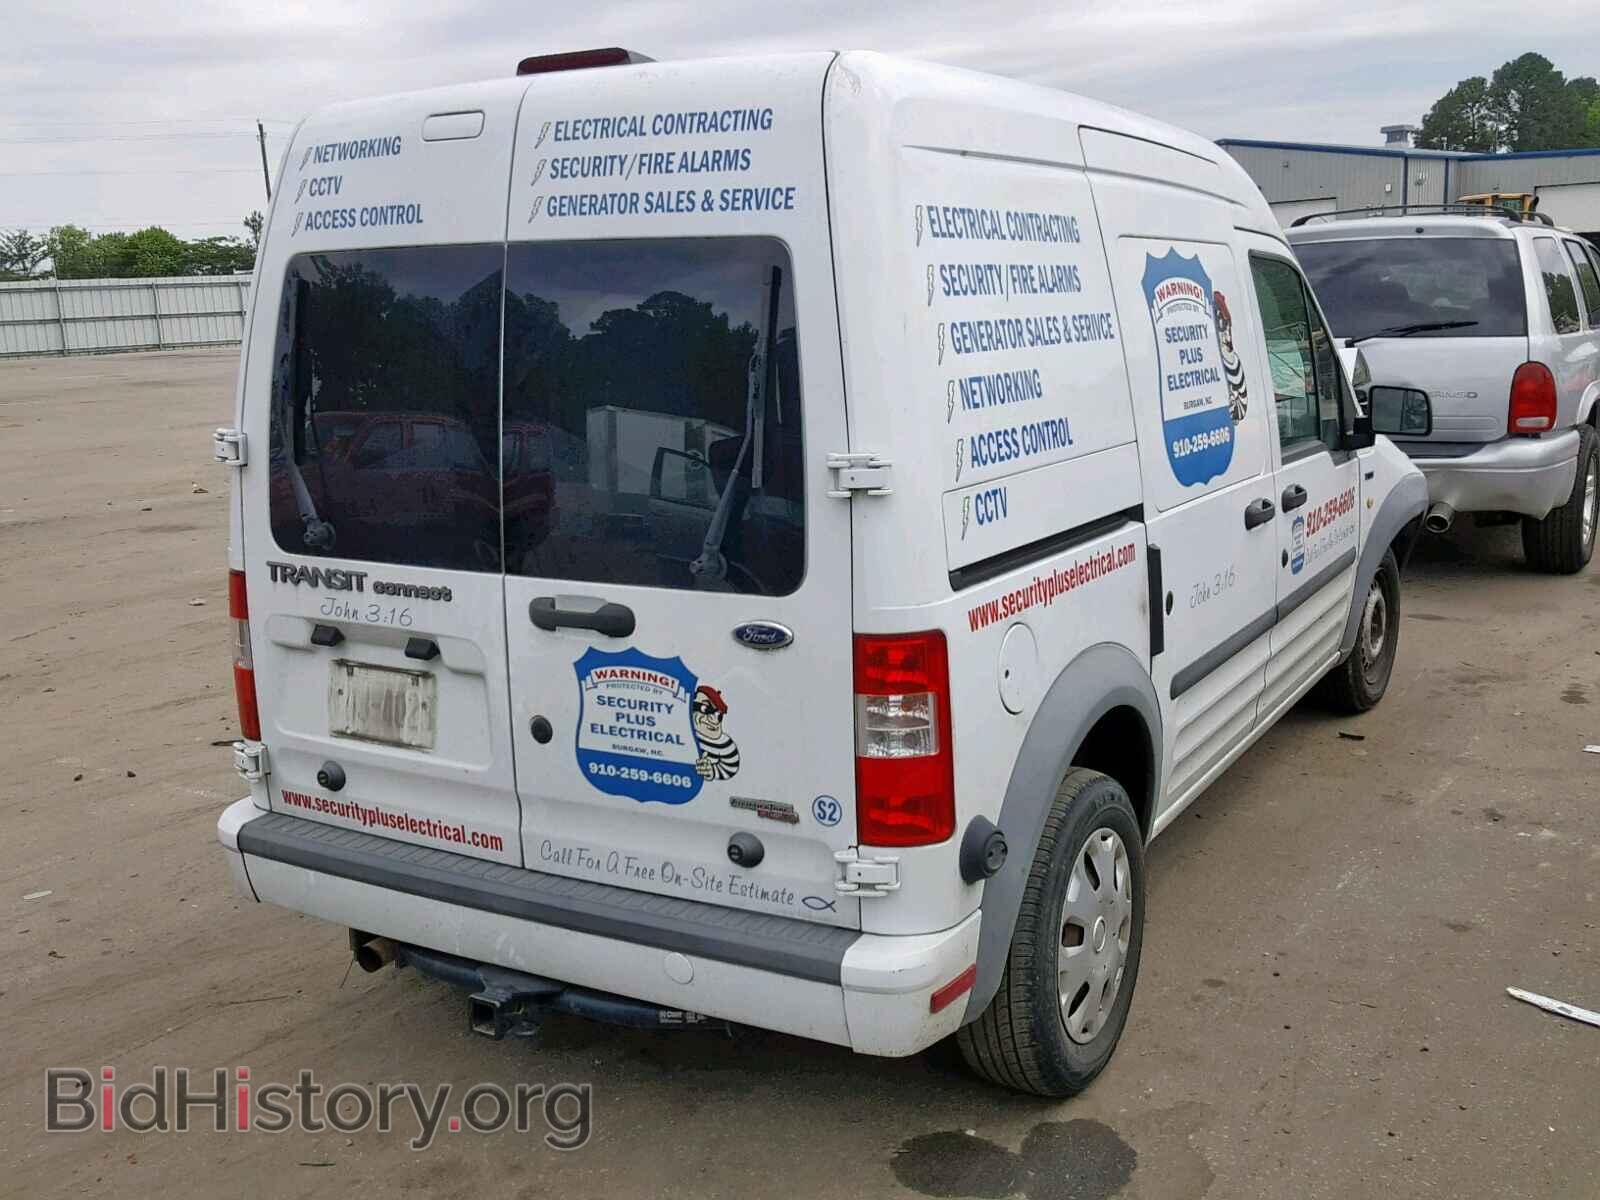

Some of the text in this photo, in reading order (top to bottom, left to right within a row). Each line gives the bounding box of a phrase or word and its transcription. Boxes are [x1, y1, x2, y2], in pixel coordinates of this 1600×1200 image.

[554, 108, 773, 142] ELECTRICAL CONTRACTING
[313, 135, 402, 164] NETWORKING
[678, 148, 752, 173] ALARMS
[309, 176, 343, 197] CCTV
[547, 187, 796, 217] GENERATOR SALES & SERVICE
[305, 203, 423, 231] ACCESS CONTROL
[927, 205, 1080, 243] ELECTRICAL CONTRACTING
[1038, 264, 1082, 293] ALARMS
[1157, 282, 1203, 302] WARNING!
[950, 313, 1114, 354] GENERATOR SALES & SERIVCE
[1165, 323, 1208, 344] SECURITY
[1179, 347, 1203, 364] PLUS
[959, 369, 1042, 410] NETWORKING
[1167, 367, 1221, 391] ELECTRICAL
[970, 417, 1073, 468] ACCESS CONTROL
[1172, 426, 1230, 458] 910-259-6606
[975, 487, 1007, 525] CCTV
[266, 561, 453, 602] TRANSIT connect
[968, 543, 1136, 632] www.securitypluselectrical.com
[321, 597, 413, 627] John 3:16
[743, 627, 777, 642] Ford
[594, 669, 676, 689] WARNING!
[596, 695, 674, 714] SECURITY
[616, 712, 656, 727] PLUS
[591, 723, 685, 746] ELECTRICAL
[588, 762, 692, 788] 910-259-6606
[281, 789, 503, 851] www.securitypluselectrical.com
[817, 800, 837, 822] S2
[541, 839, 794, 905] Call For A Free On-Site Estimate
